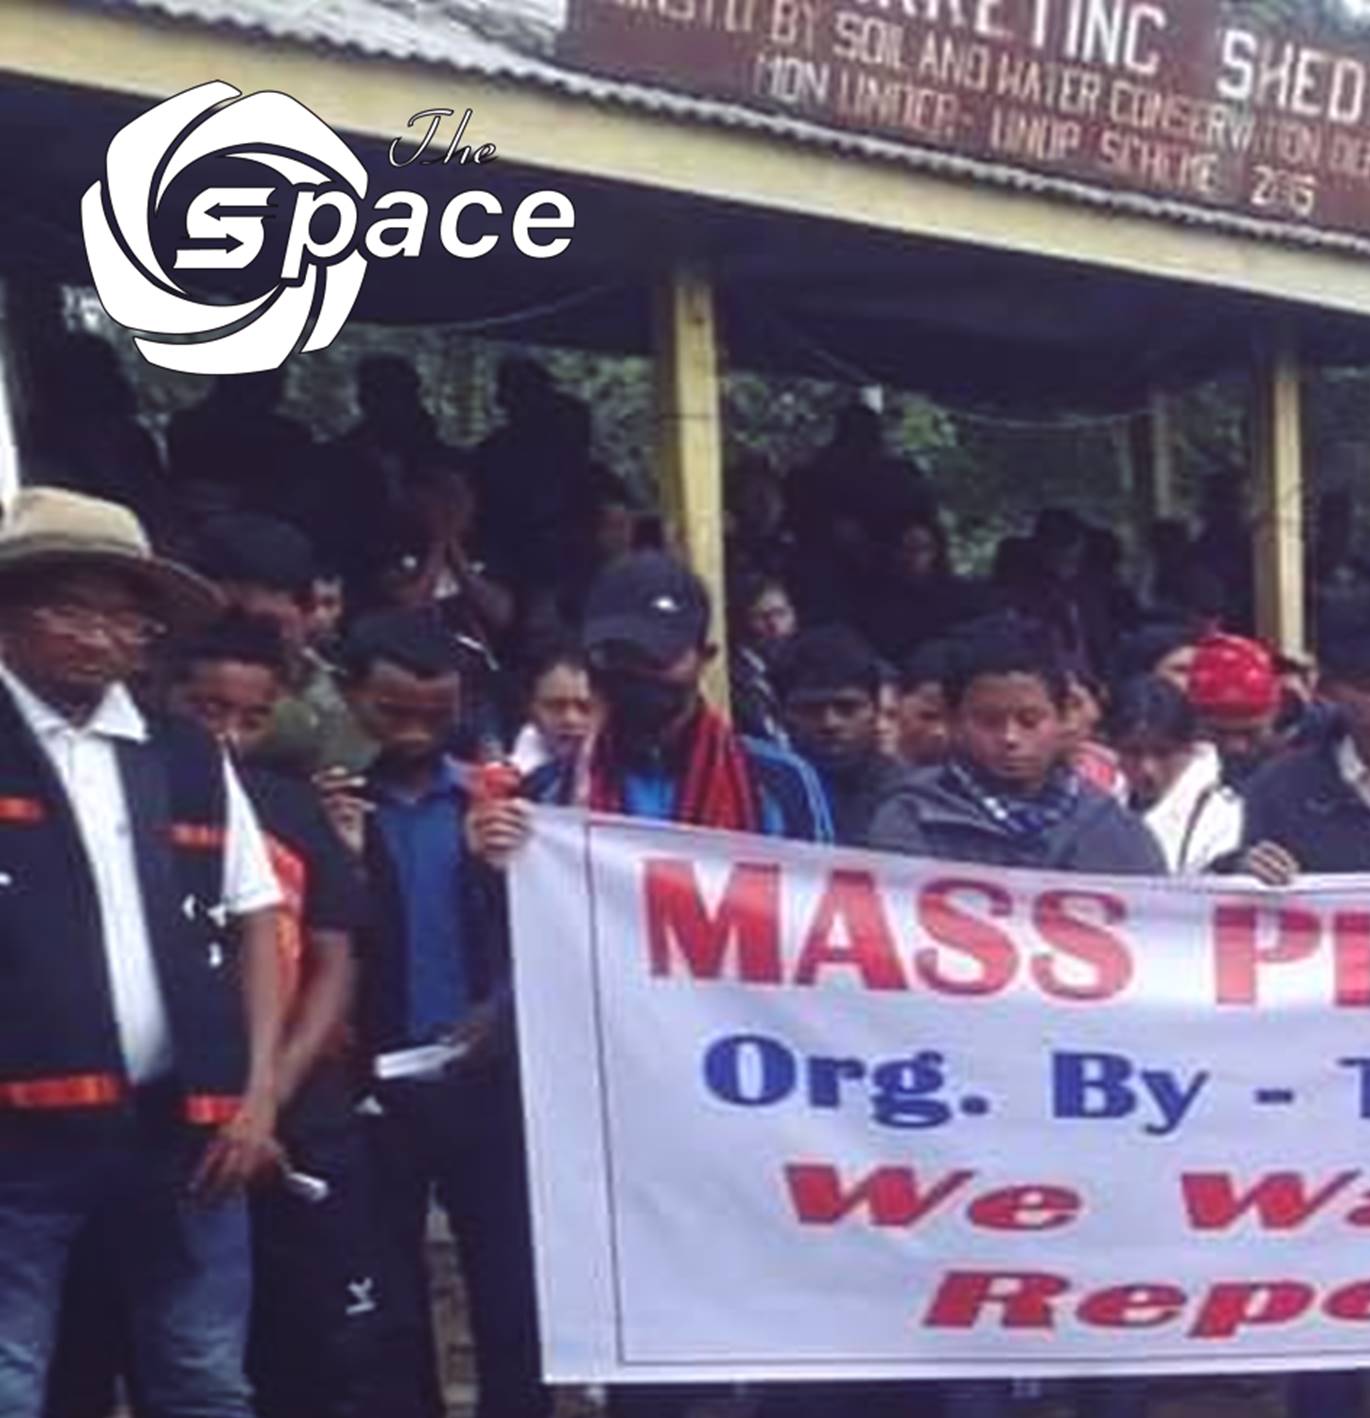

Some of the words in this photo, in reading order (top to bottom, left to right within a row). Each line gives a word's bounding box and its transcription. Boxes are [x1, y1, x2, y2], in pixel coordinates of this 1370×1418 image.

[770, 0, 824, 51] BY
[833, 10, 906, 72] SOIL
[918, 30, 990, 92] AND
[1216, 29, 1364, 125] SHED
[641, 858, 1134, 1003] MASS
[703, 1034, 990, 1130] Org.
[1052, 1050, 1209, 1136] By
[781, 1163, 1084, 1232] We
